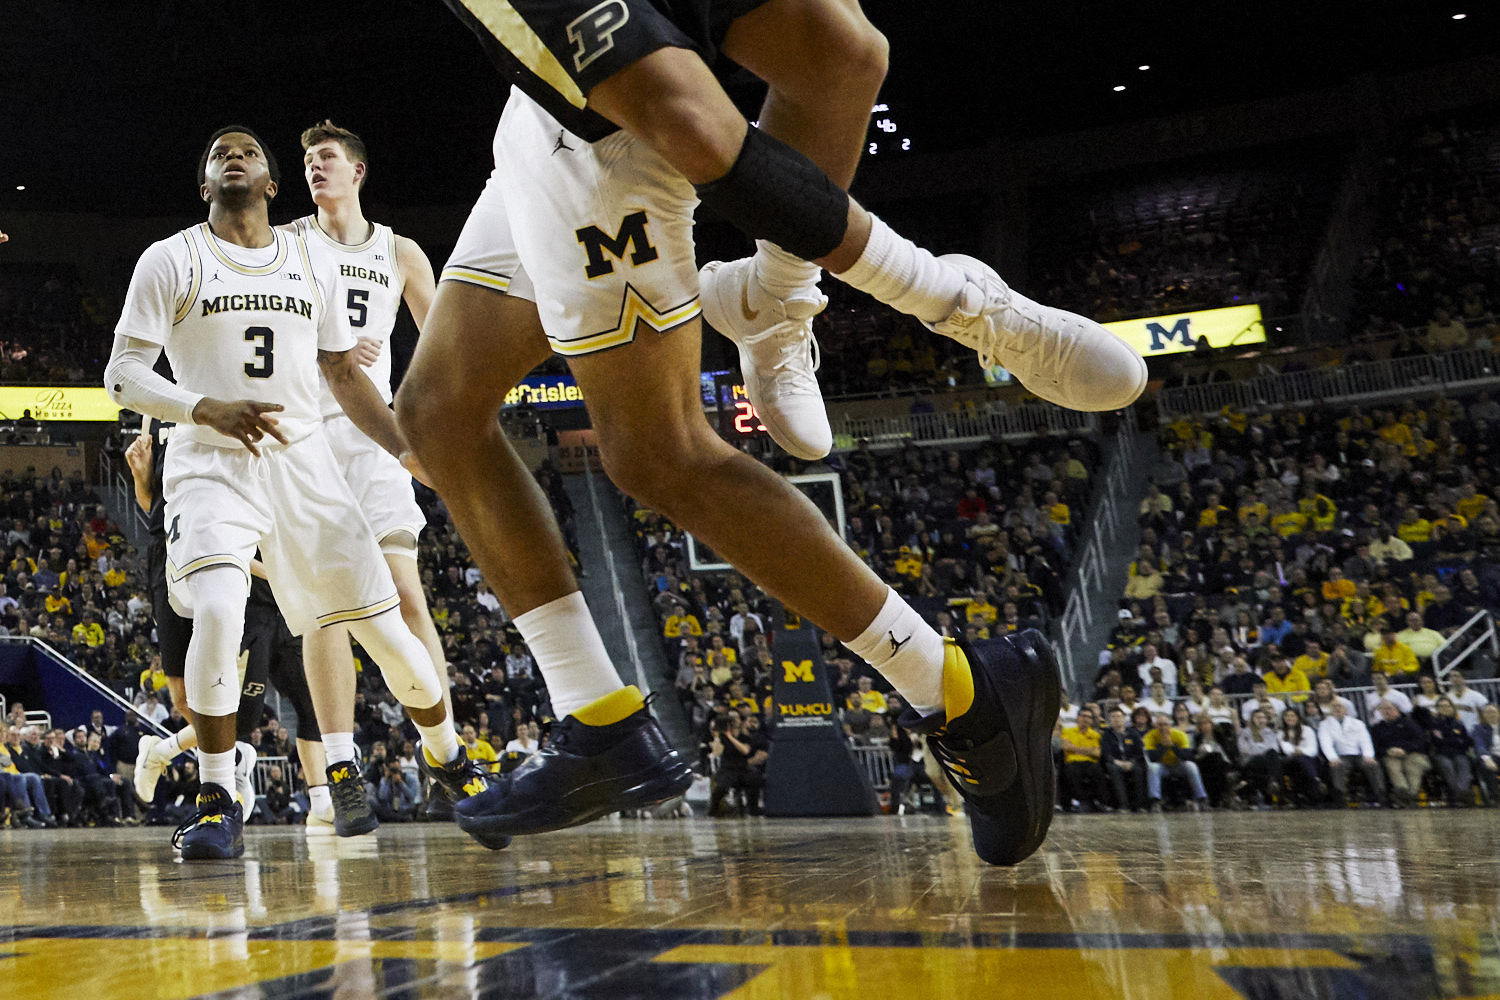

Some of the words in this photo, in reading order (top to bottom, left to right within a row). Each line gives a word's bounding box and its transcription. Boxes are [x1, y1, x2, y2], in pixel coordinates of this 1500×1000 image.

[575, 210, 659, 281] M
[339, 264, 389, 288] HIGAN
[202, 294, 313, 320] MICHIGAN
[1146, 318, 1195, 351] M
[243, 326, 275, 379] 3
[781, 660, 815, 683] M
